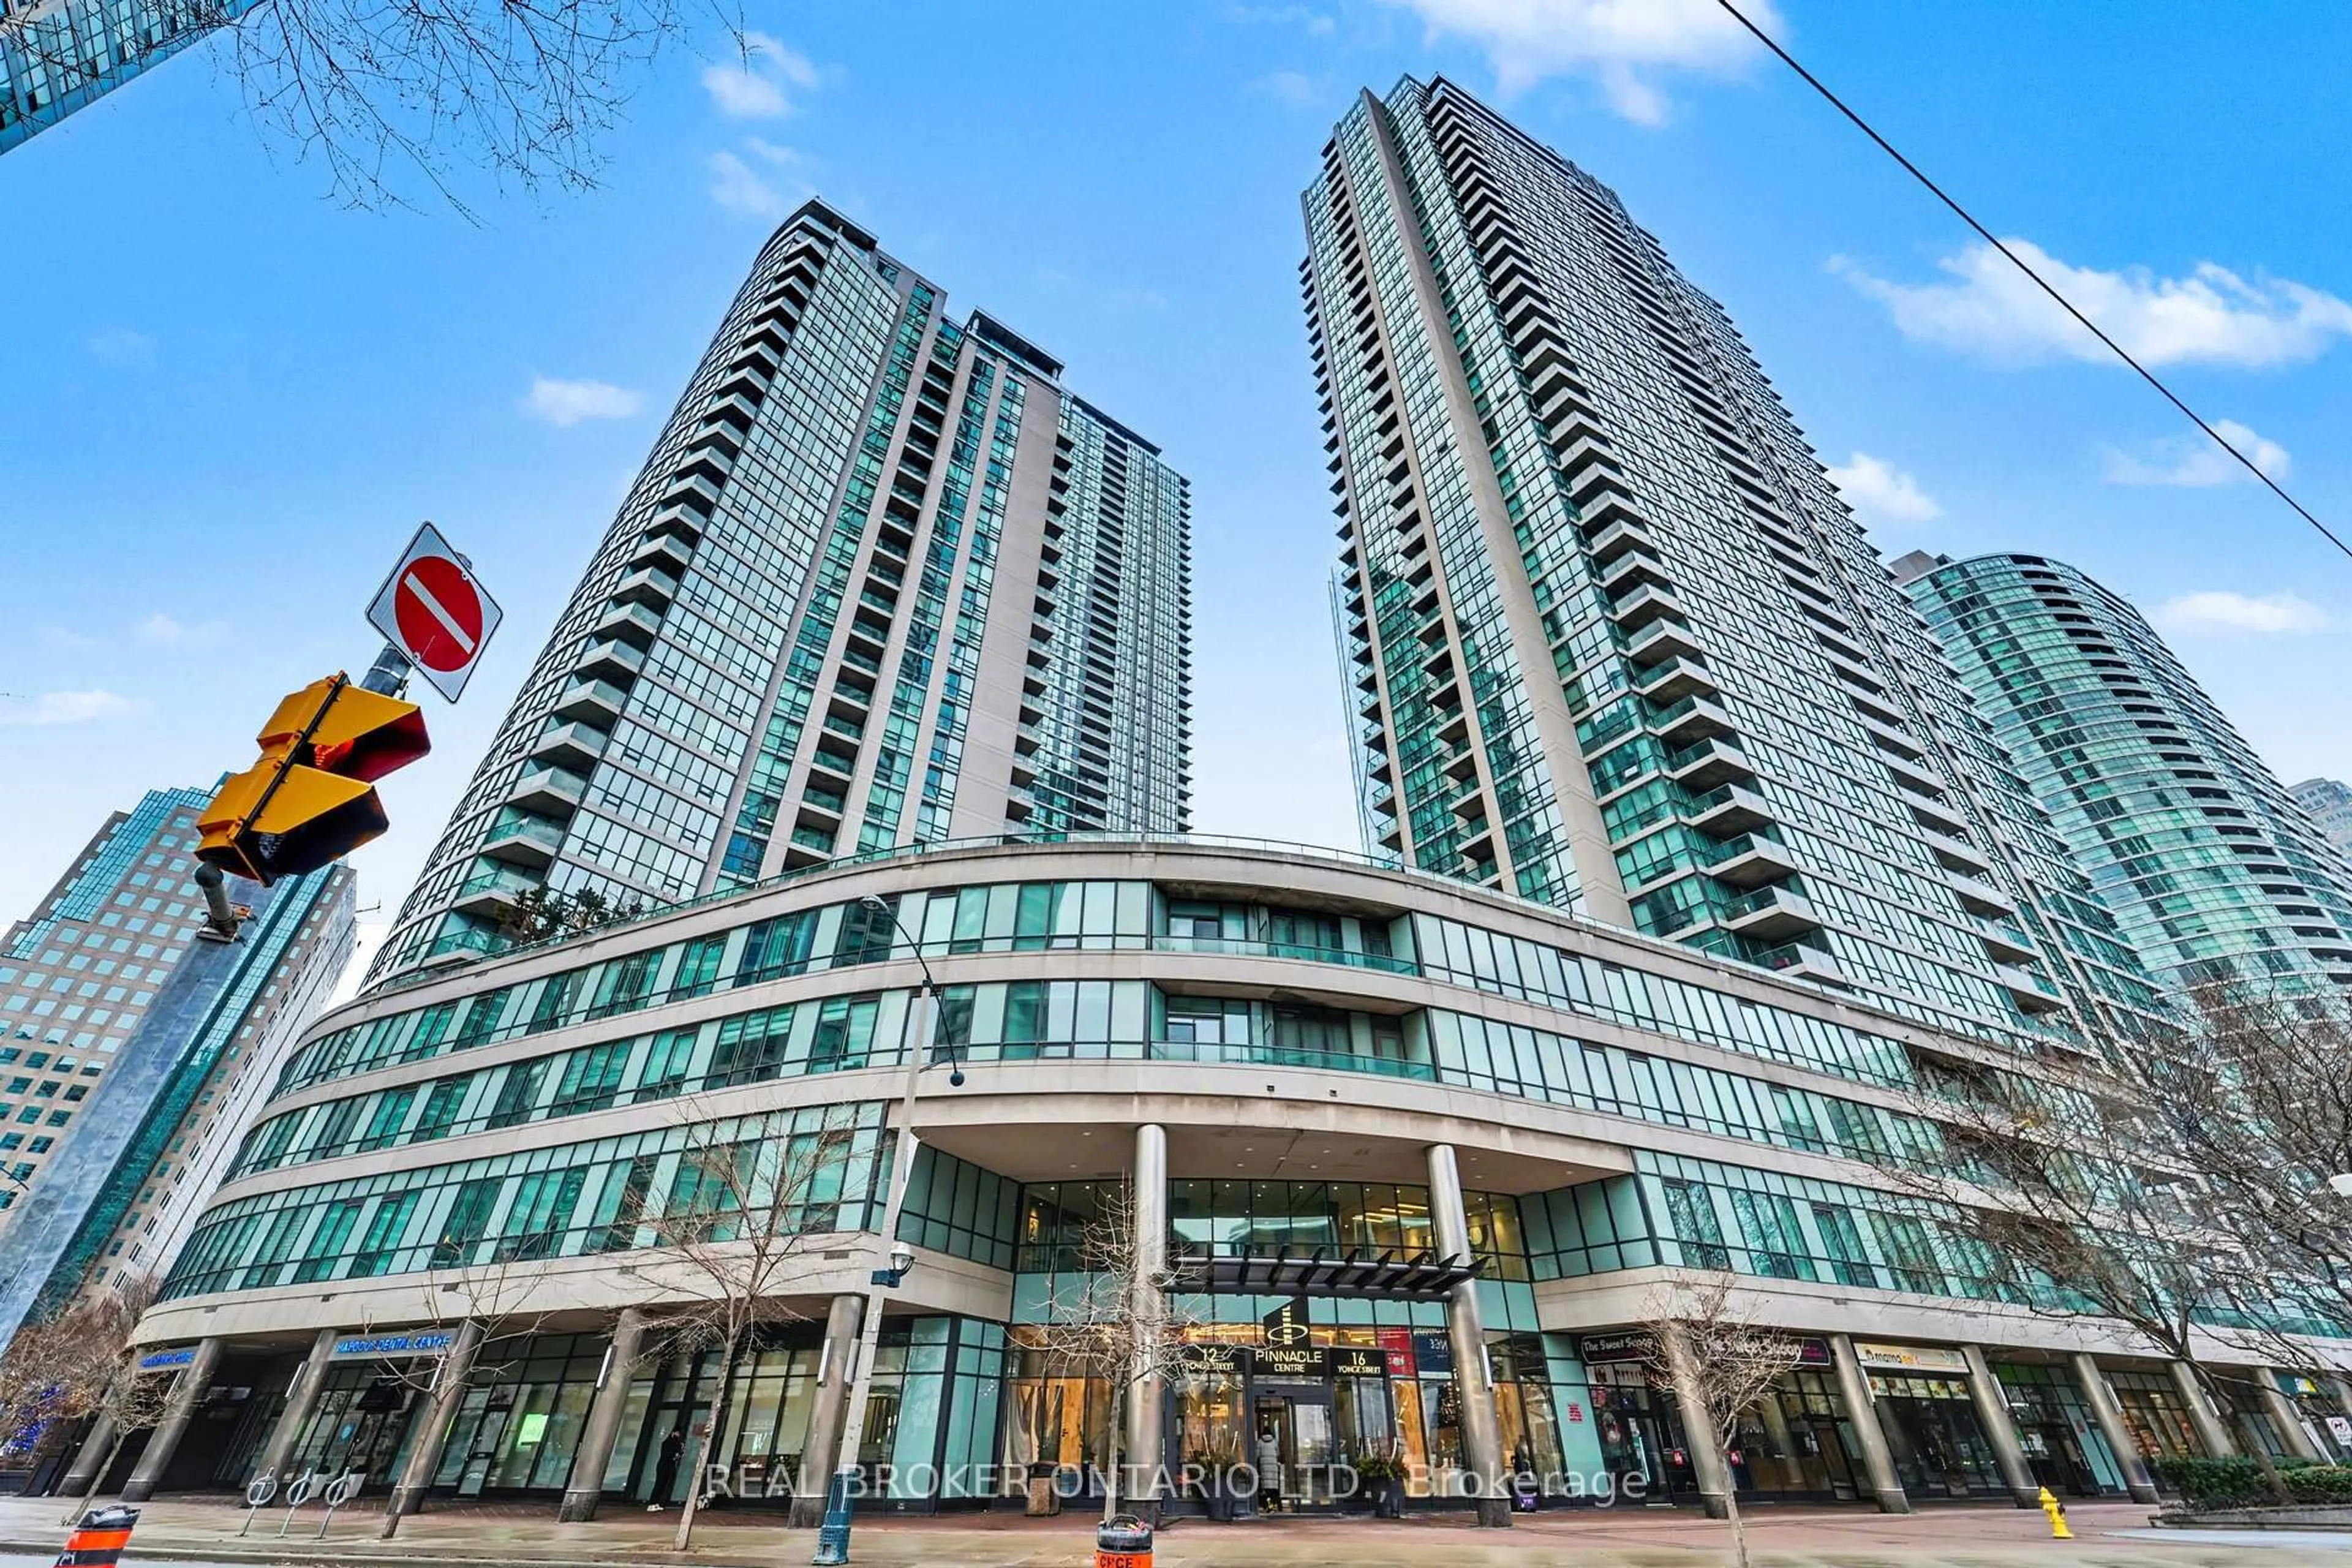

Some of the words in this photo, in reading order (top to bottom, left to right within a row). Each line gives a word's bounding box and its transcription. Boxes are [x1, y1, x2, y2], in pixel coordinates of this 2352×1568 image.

[376, 1336, 412, 1351] DENTAL
[1584, 1341, 1598, 1352] The
[1599, 1338, 1624, 1351] Sweet
[1204, 1348, 1219, 1362] 12
[1255, 1350, 1323, 1363] PINNACLE
[1352, 1351, 1366, 1366] 16
[1274, 1363, 1305, 1373] CENTRE
